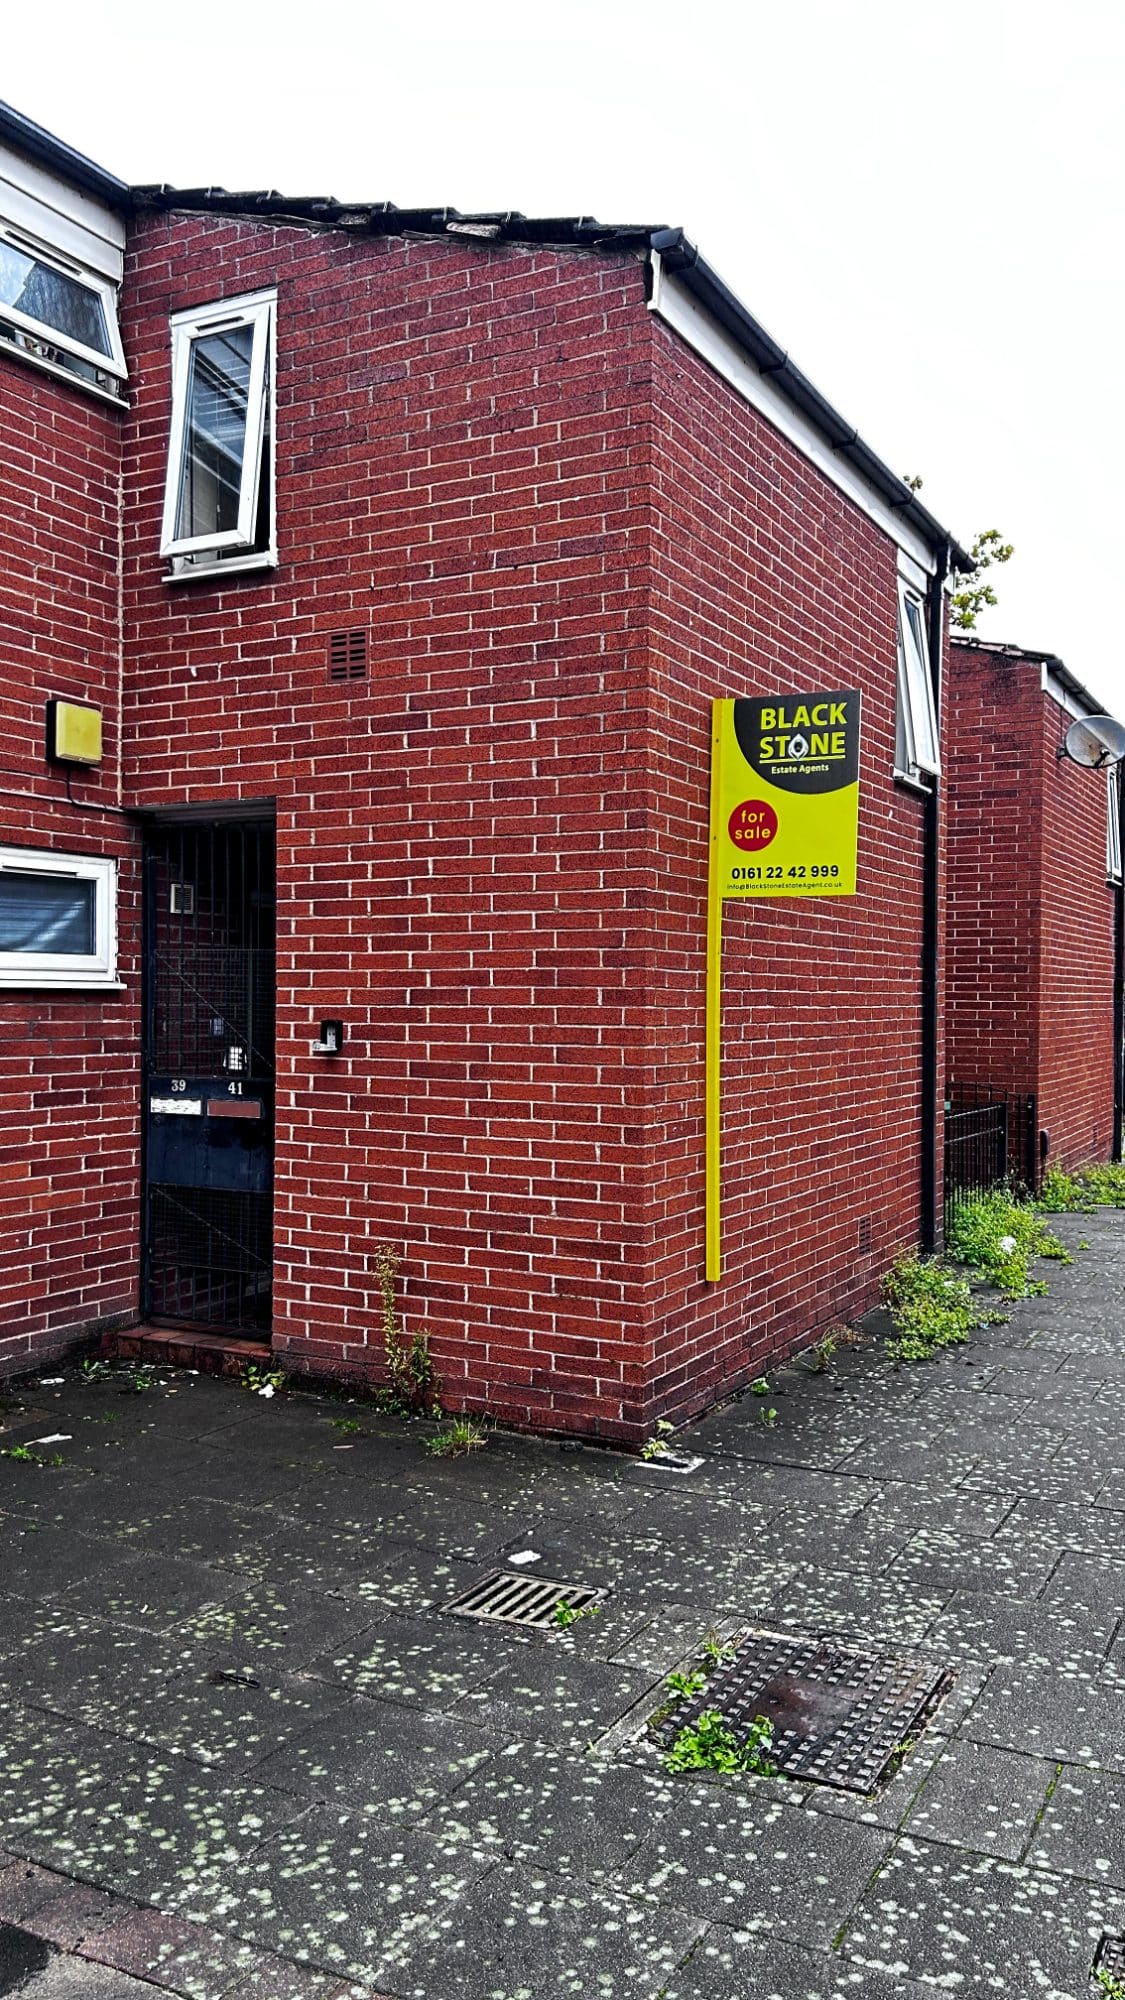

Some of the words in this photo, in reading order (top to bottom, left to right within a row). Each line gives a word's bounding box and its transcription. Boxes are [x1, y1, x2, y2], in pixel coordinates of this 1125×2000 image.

[761, 702, 848, 730] BLACK
[760, 732, 846, 760] STONE
[771, 766, 797, 774] Estate
[799, 764, 829, 774] Agents
[741, 810, 765, 823] for
[735, 825, 771, 840] sale
[731, 867, 762, 879] 0161
[766, 866, 783, 879] 22
[787, 866, 806, 878] 42
[810, 865, 839, 877] 999
[727, 882, 842, 890] info@BlackStoneEstateAgent.couk
[171, 1080, 186, 1091] 39
[227, 1082, 243, 1095] 41
